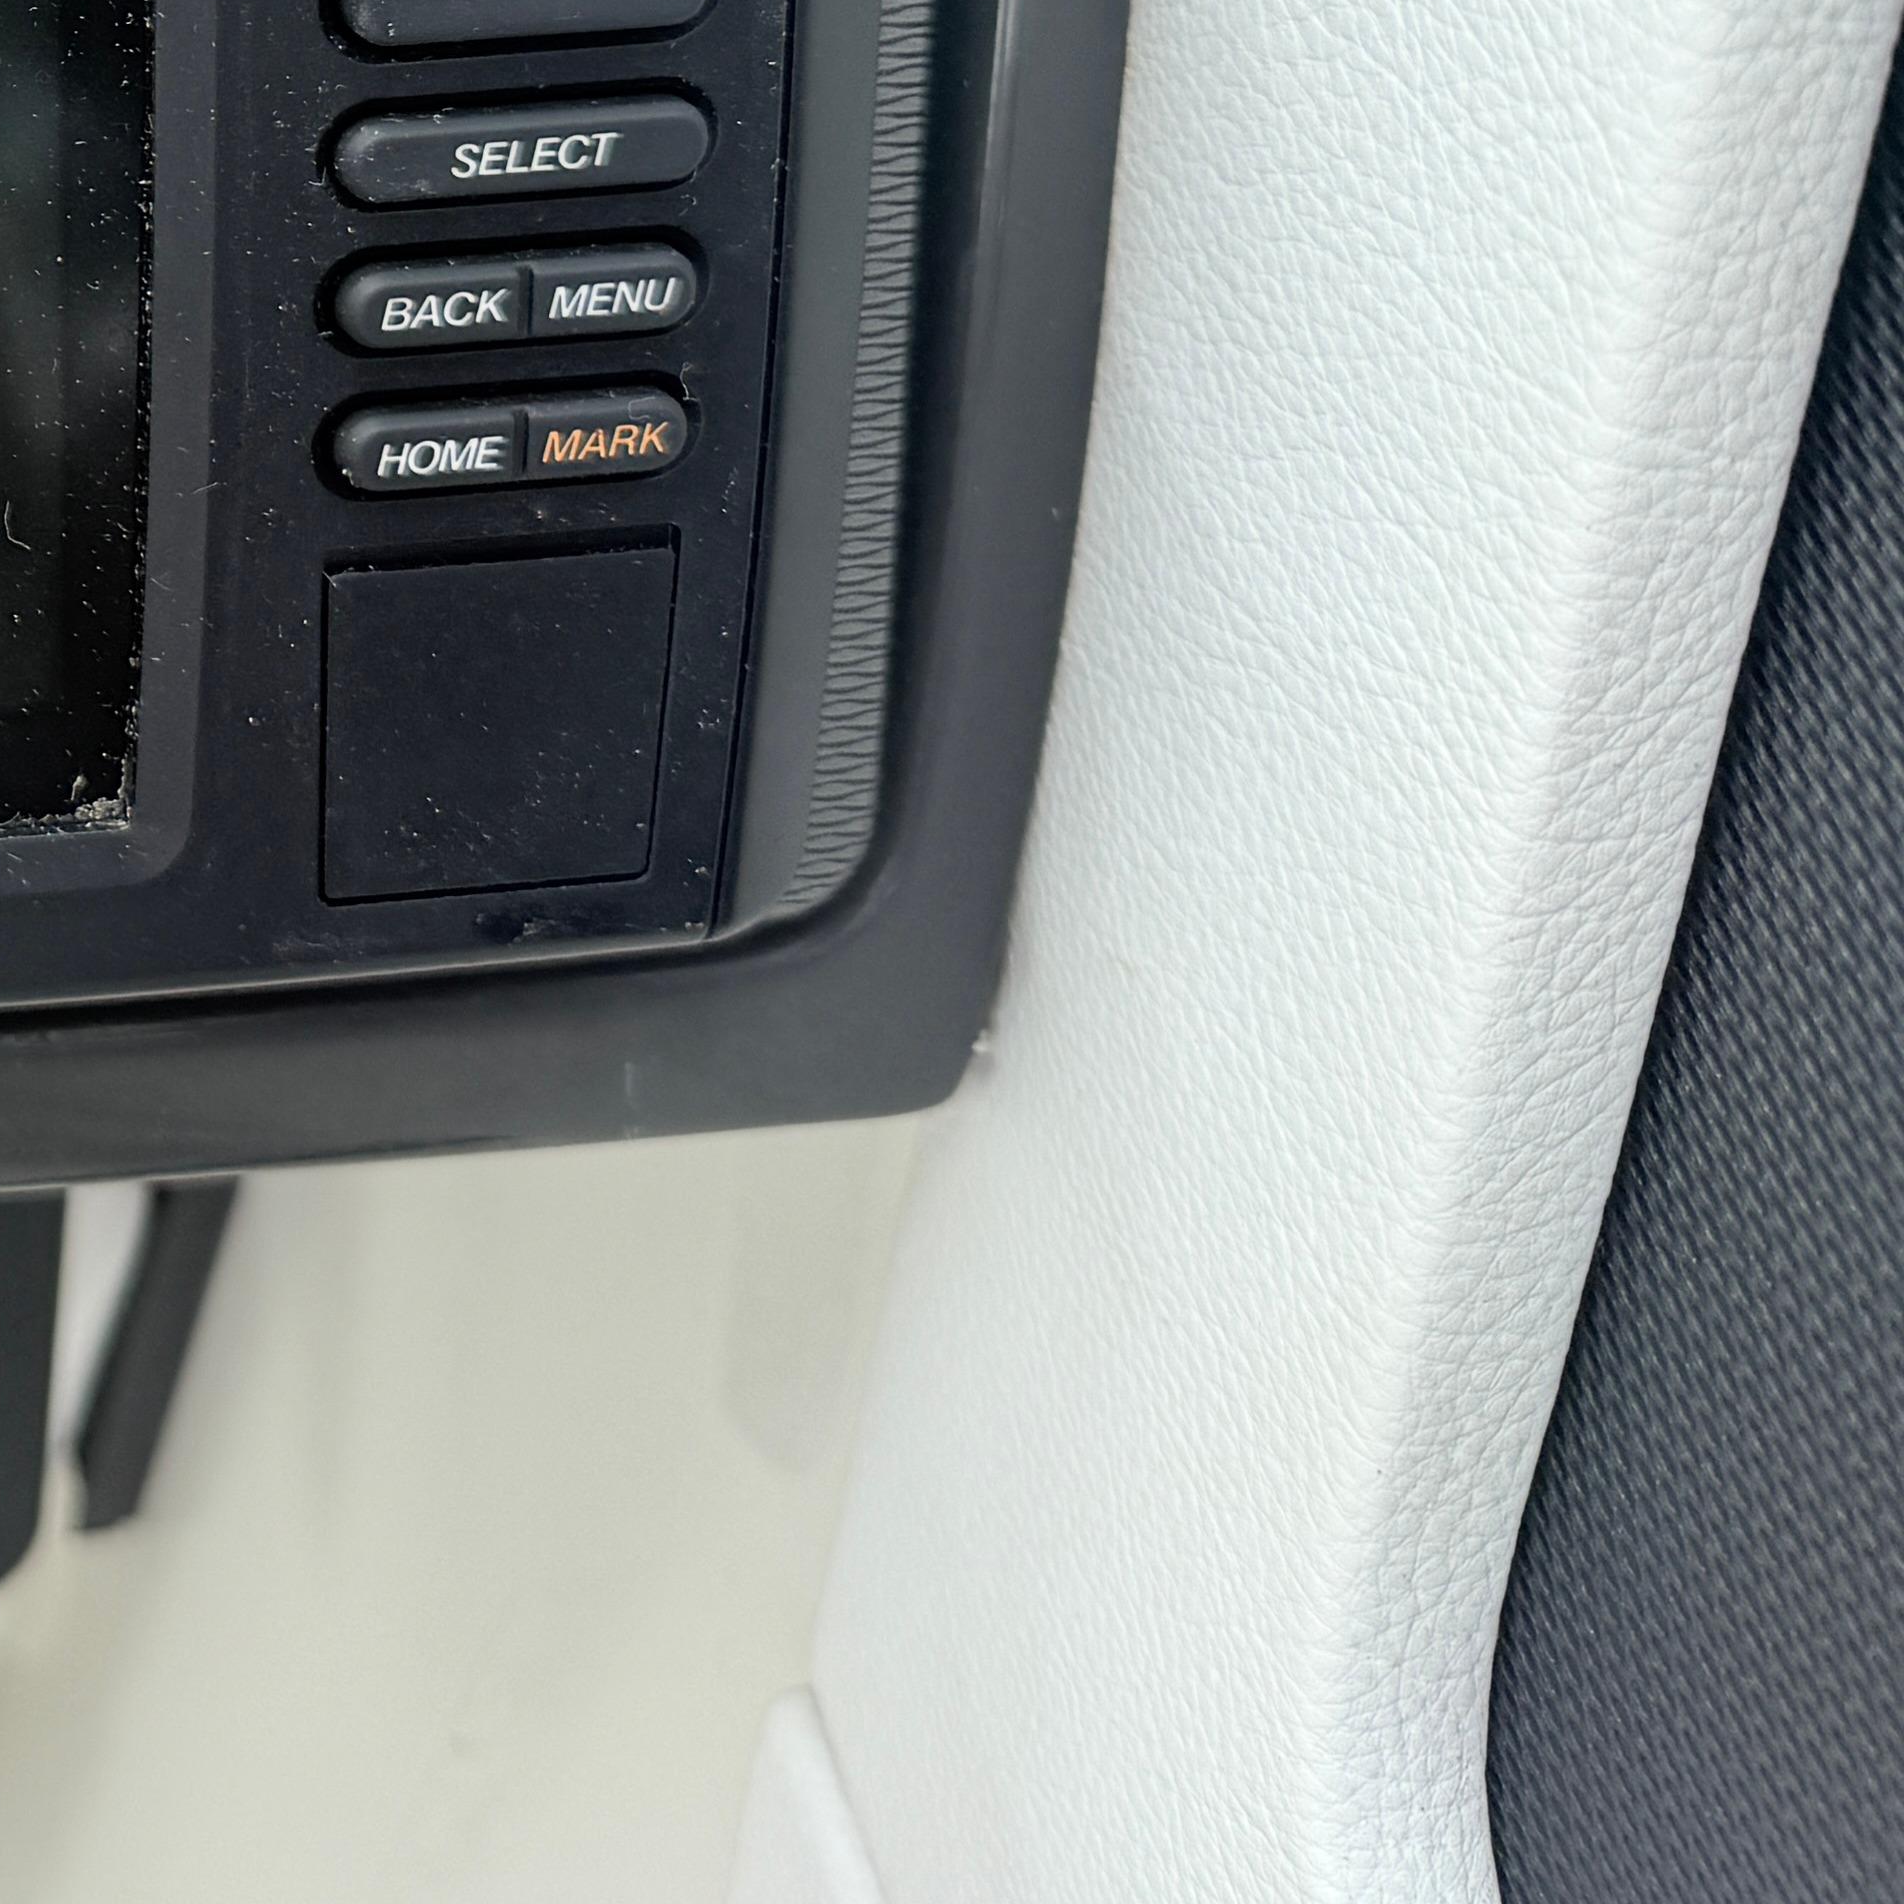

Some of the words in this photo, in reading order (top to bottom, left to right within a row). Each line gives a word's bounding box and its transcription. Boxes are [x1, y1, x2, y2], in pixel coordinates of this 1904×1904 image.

[450, 131, 621, 179] SELECT
[380, 289, 513, 332] BACK
[547, 276, 678, 321] MENU
[376, 434, 505, 478] HOME
[541, 420, 669, 464] MARK
